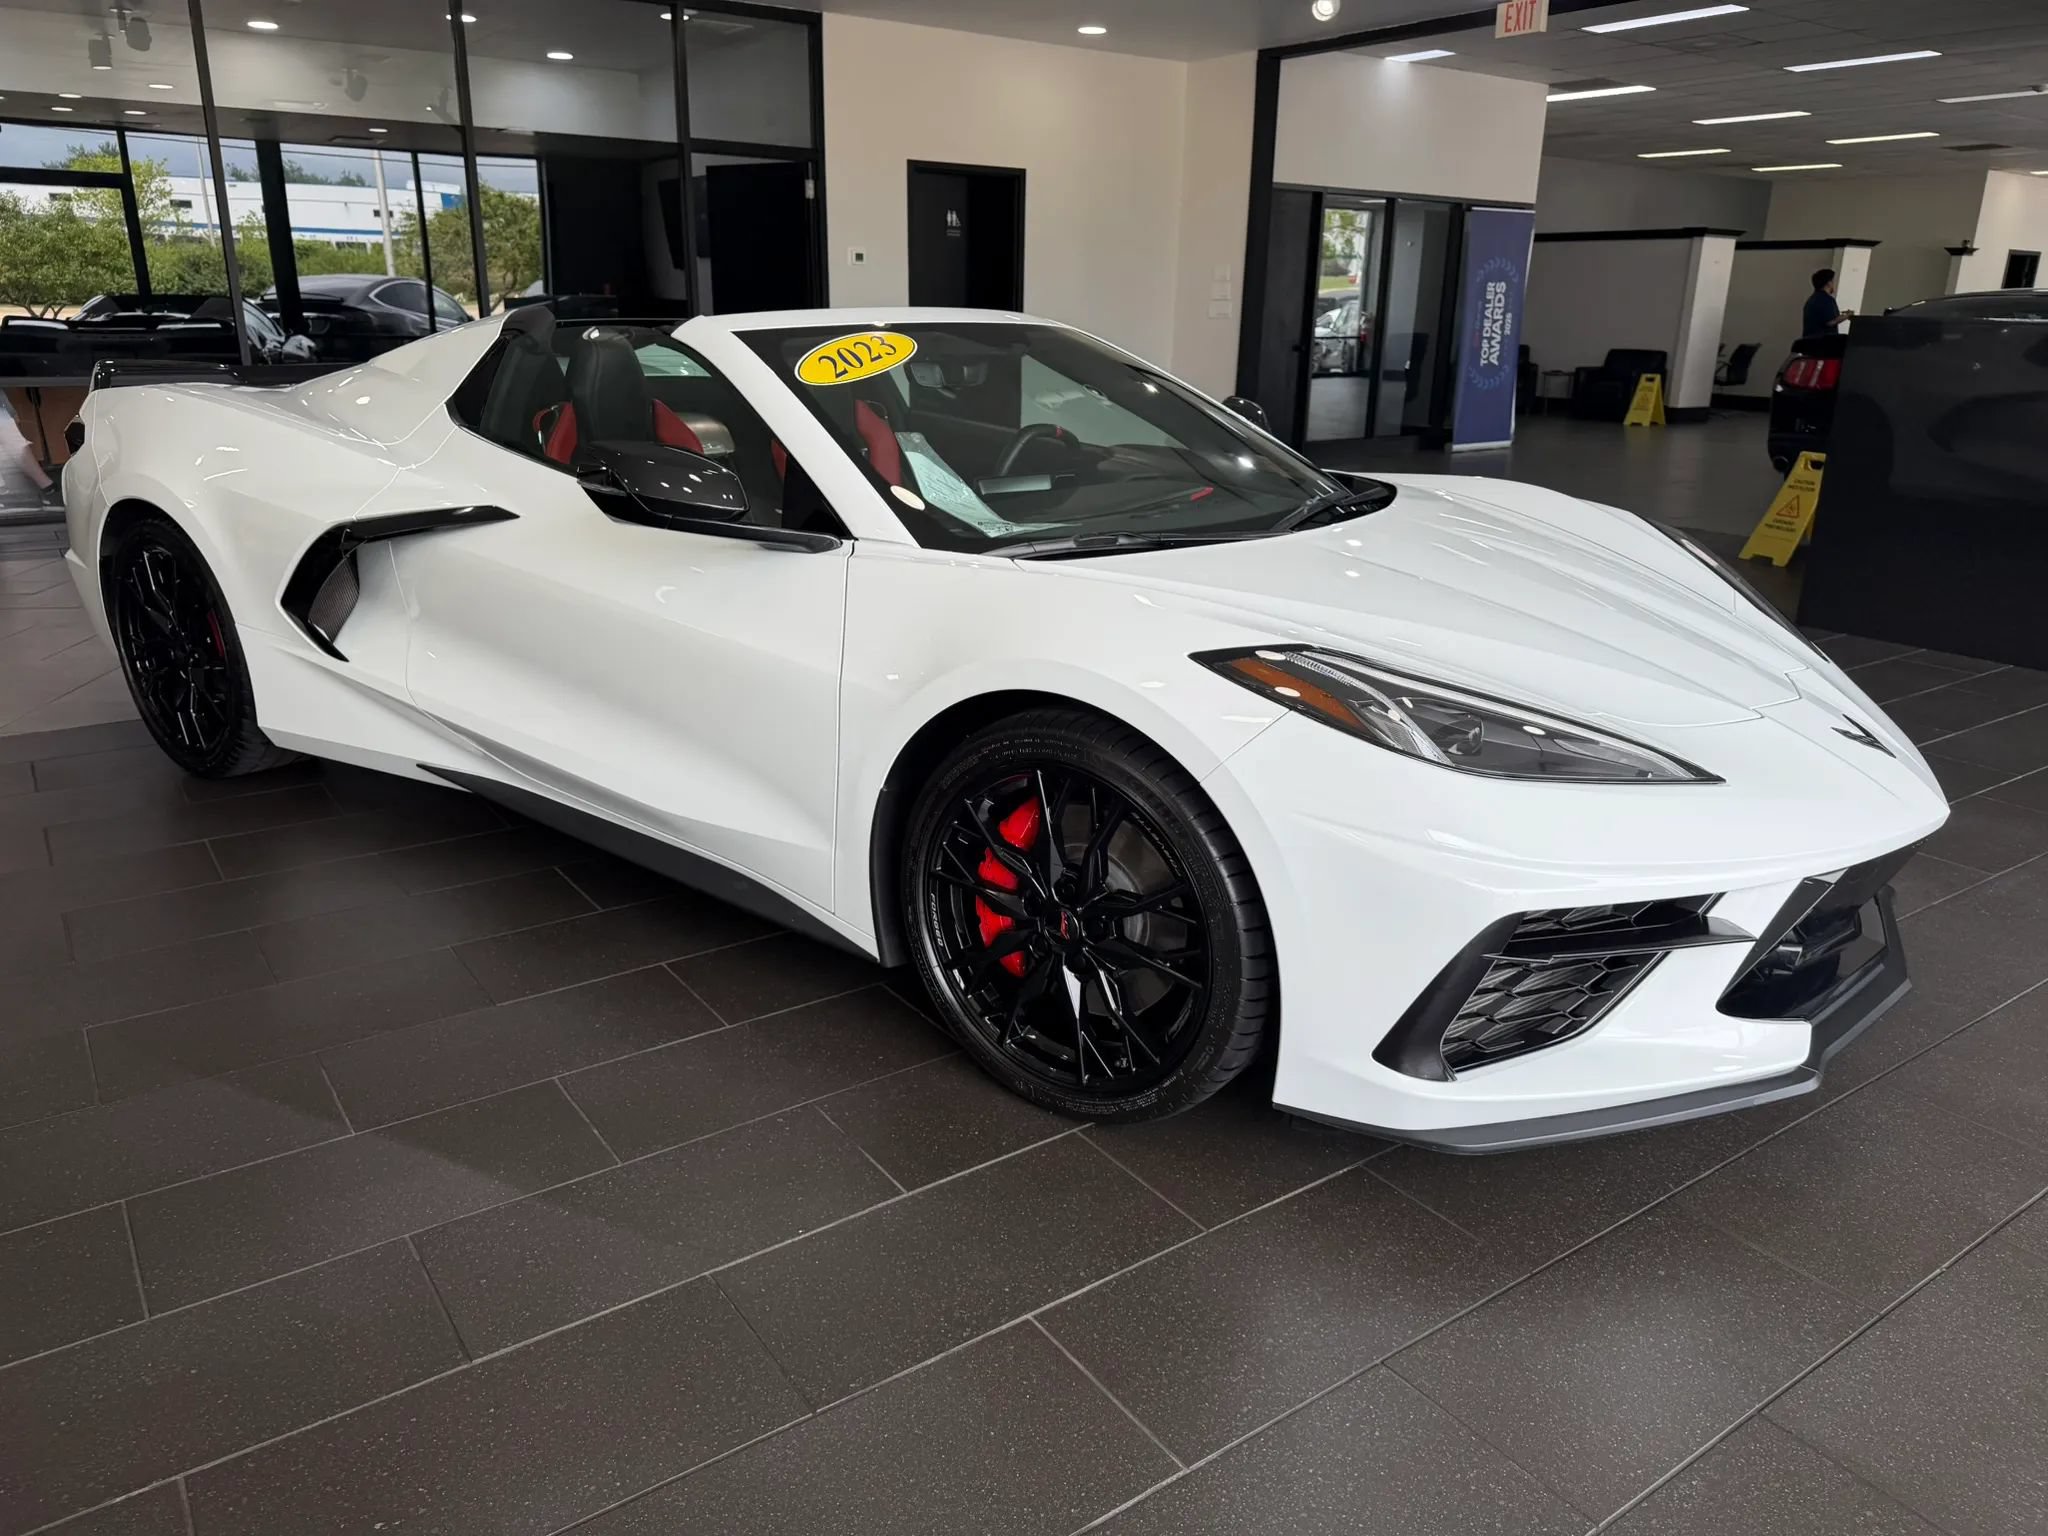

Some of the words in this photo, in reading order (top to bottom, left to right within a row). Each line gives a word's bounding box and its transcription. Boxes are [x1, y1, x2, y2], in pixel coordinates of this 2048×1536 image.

[1504, 0, 1536, 32] EXIT
[1482, 281, 1496, 337] DEALER
[1489, 281, 1507, 366] AWARDS
[818, 335, 897, 379] 2023
[1480, 339, 1490, 367] TOP
[930, 892, 944, 947] FORGED
